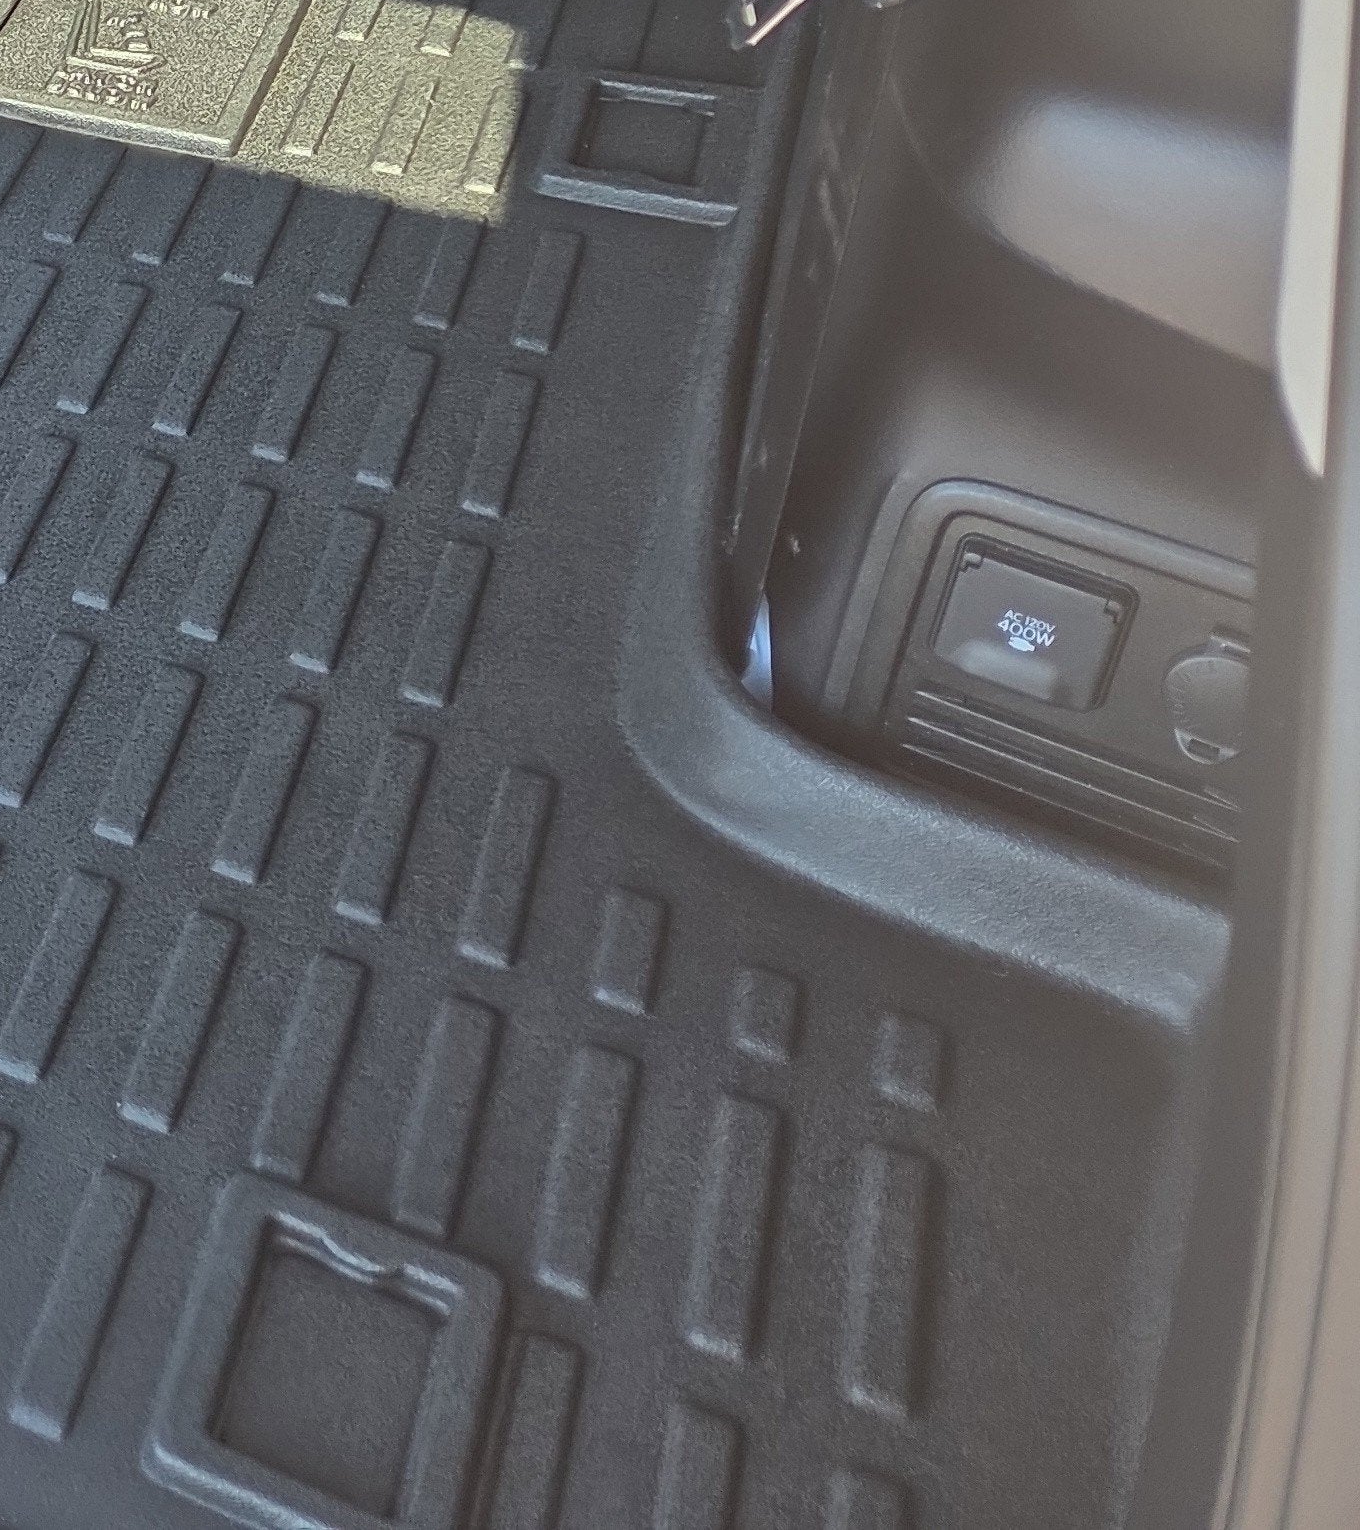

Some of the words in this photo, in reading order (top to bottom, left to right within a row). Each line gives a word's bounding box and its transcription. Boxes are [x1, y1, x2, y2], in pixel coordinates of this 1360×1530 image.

[997, 619, 1056, 647] 400W
[1004, 609, 1023, 623] AC
[1024, 615, 1056, 633] 120V
